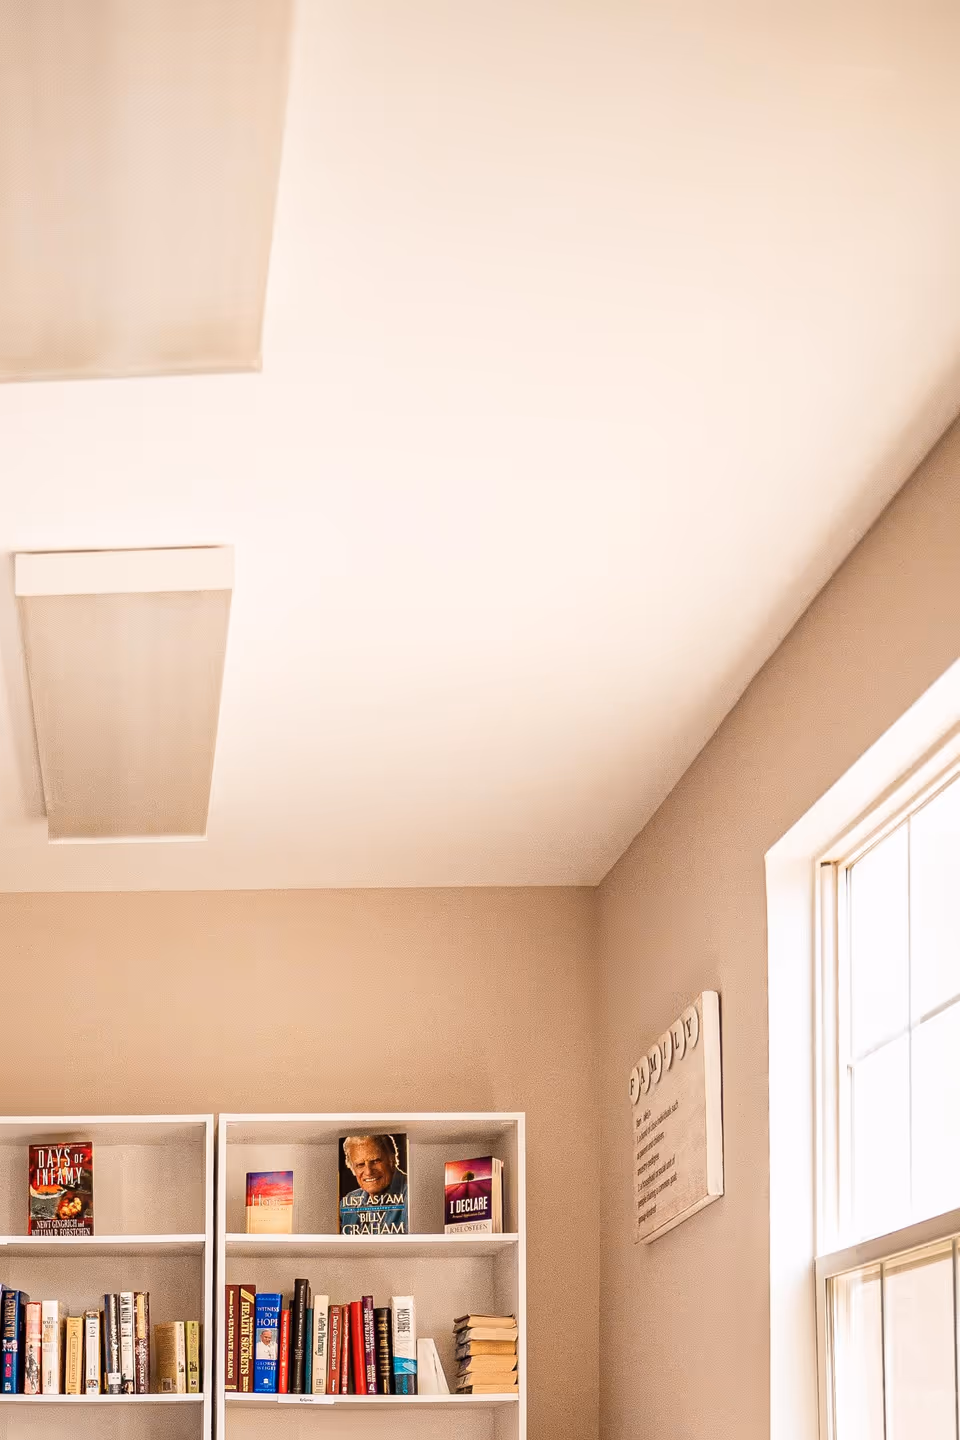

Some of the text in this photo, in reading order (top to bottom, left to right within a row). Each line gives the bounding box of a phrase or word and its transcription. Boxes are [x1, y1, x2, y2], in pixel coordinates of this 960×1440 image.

[38, 1148, 84, 1168] DAYS OF
[36, 1167, 82, 1186] INFAMY
[342, 1196, 364, 1207] JUST
[367, 1196, 378, 1204] AS
[386, 1194, 404, 1204] AM
[456, 1196, 488, 1213] DECLARE
[36, 1220, 52, 1229] NEWT
[52, 1219, 77, 1228] GINGRICH
[360, 1212, 386, 1222] BILLY
[60, 1228, 90, 1236] FORSTCHEN
[342, 1222, 404, 1234] GRAHAM
[241, 1302, 250, 1335] HEALTH
[397, 1309, 410, 1332] MESSAGE
[241, 1337, 250, 1374] SECRETS
